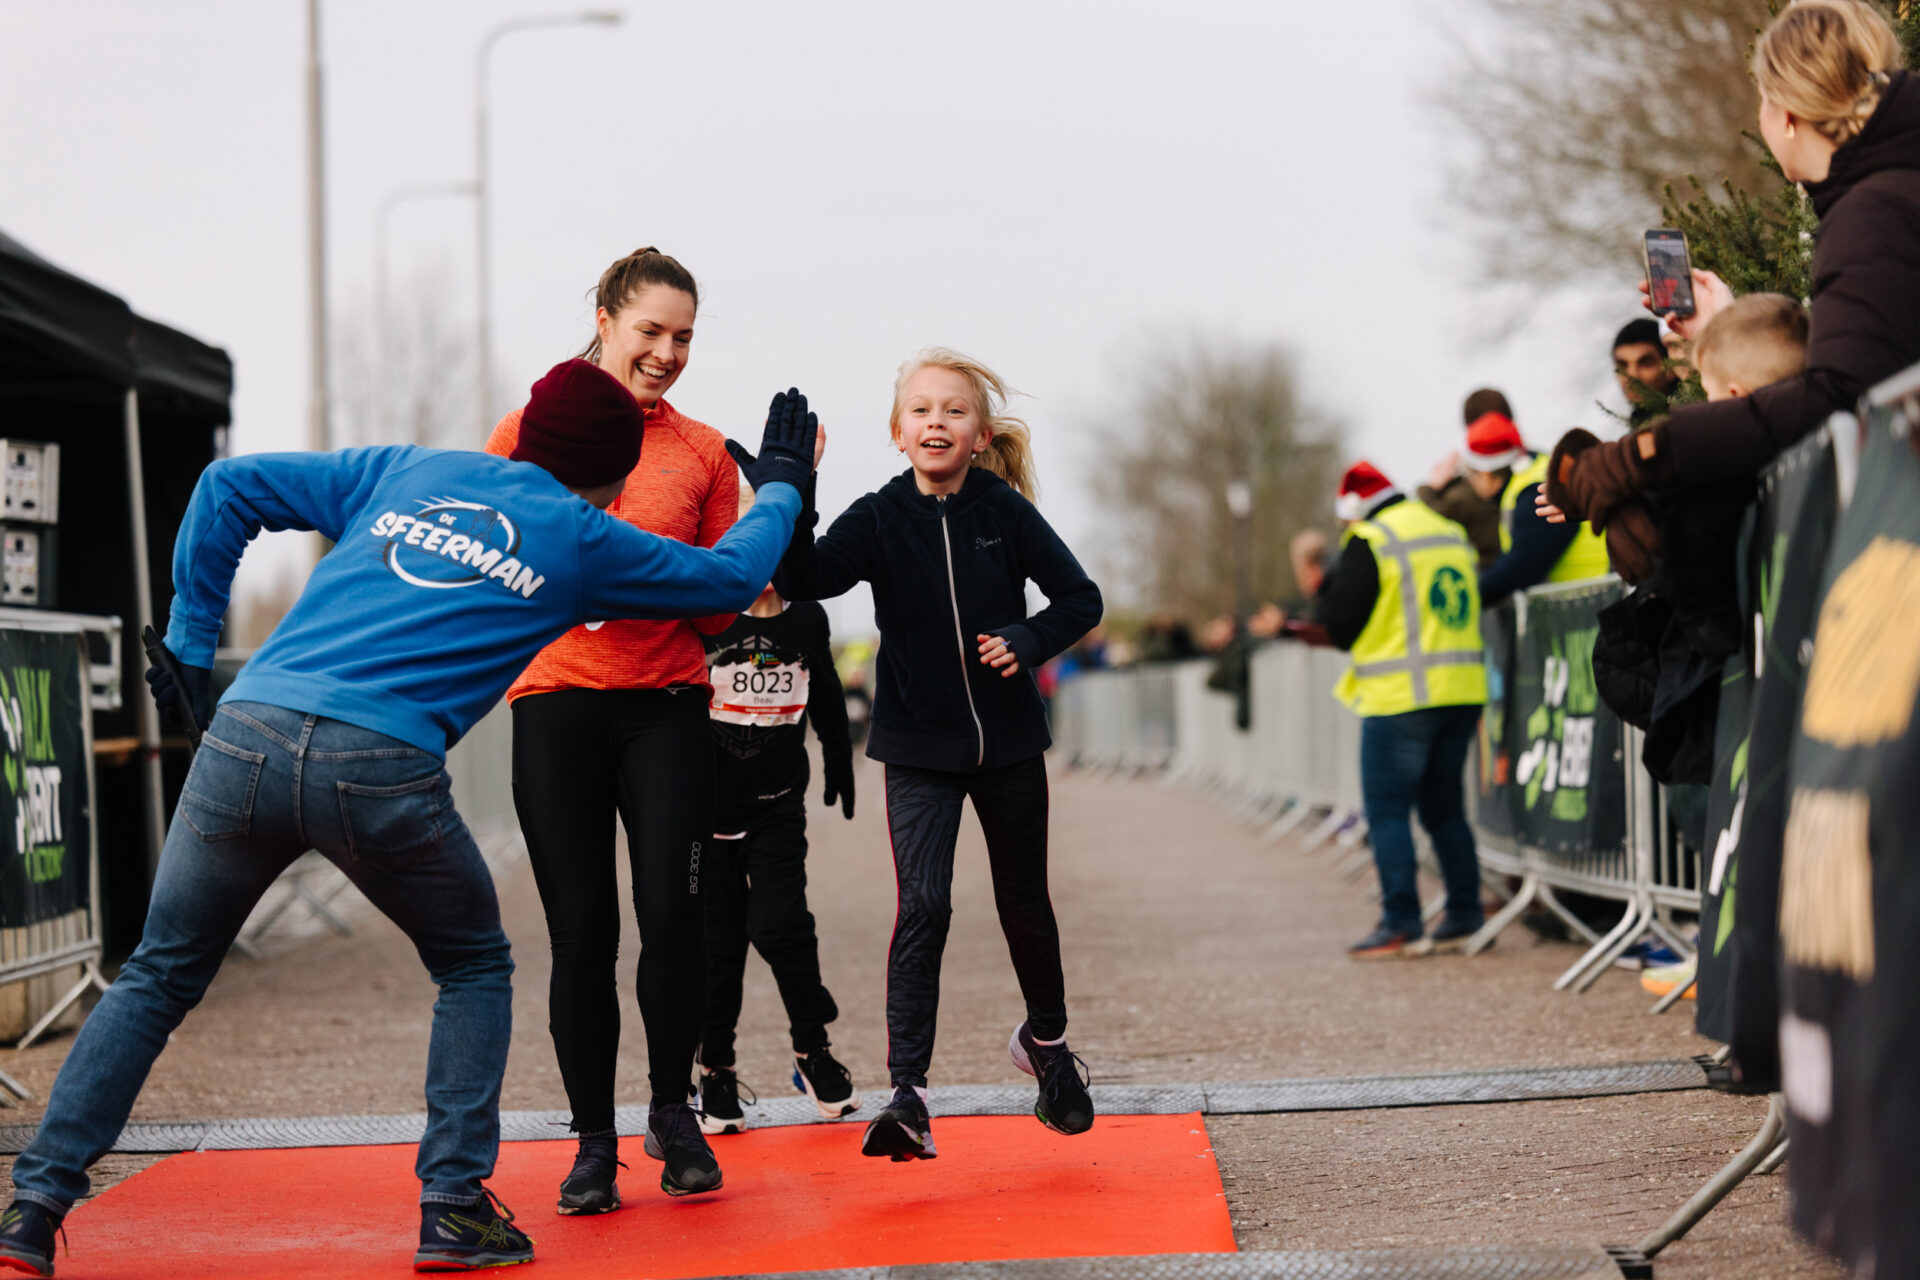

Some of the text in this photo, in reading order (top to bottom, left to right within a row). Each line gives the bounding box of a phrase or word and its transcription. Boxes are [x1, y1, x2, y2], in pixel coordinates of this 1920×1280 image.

[439, 513, 457, 526] DE
[370, 511, 546, 599] SFEERMAN
[732, 671, 793, 693] 8023
[753, 696, 774, 705] Beau
[689, 841, 702, 894] BG 3000
